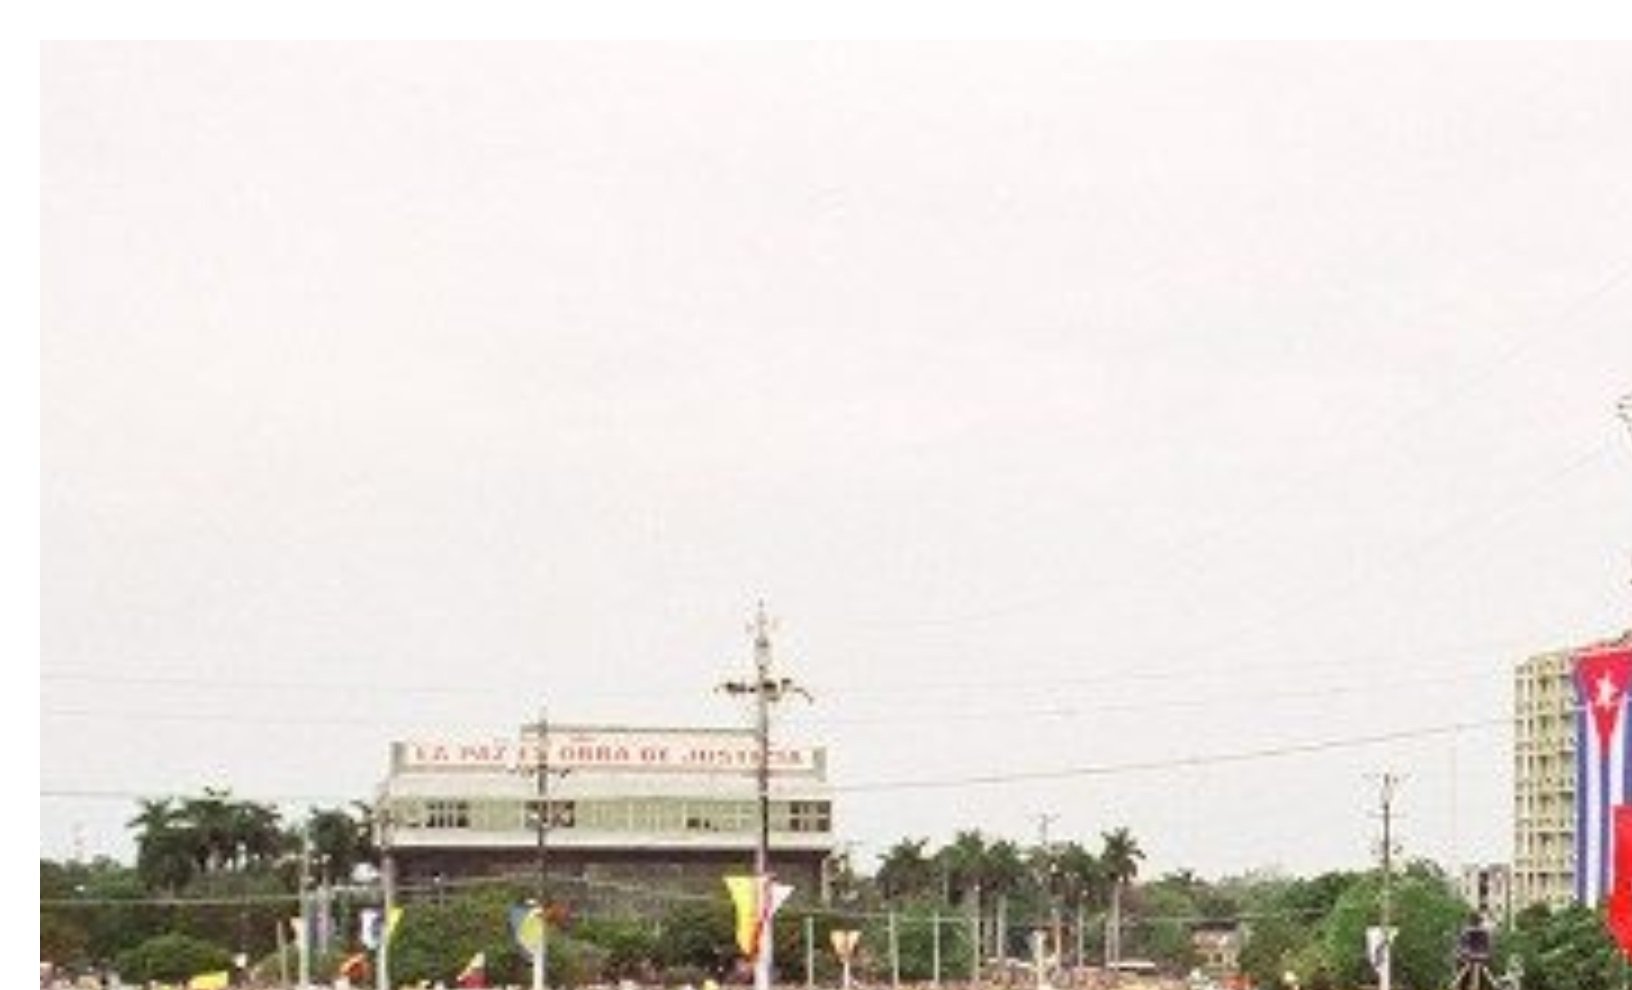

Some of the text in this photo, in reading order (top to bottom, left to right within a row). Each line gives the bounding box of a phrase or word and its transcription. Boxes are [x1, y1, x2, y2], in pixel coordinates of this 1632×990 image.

[415, 745, 450, 761] LA
[460, 745, 508, 761] PAZ
[559, 745, 630, 761] OBRA
[640, 745, 669, 762] DE
